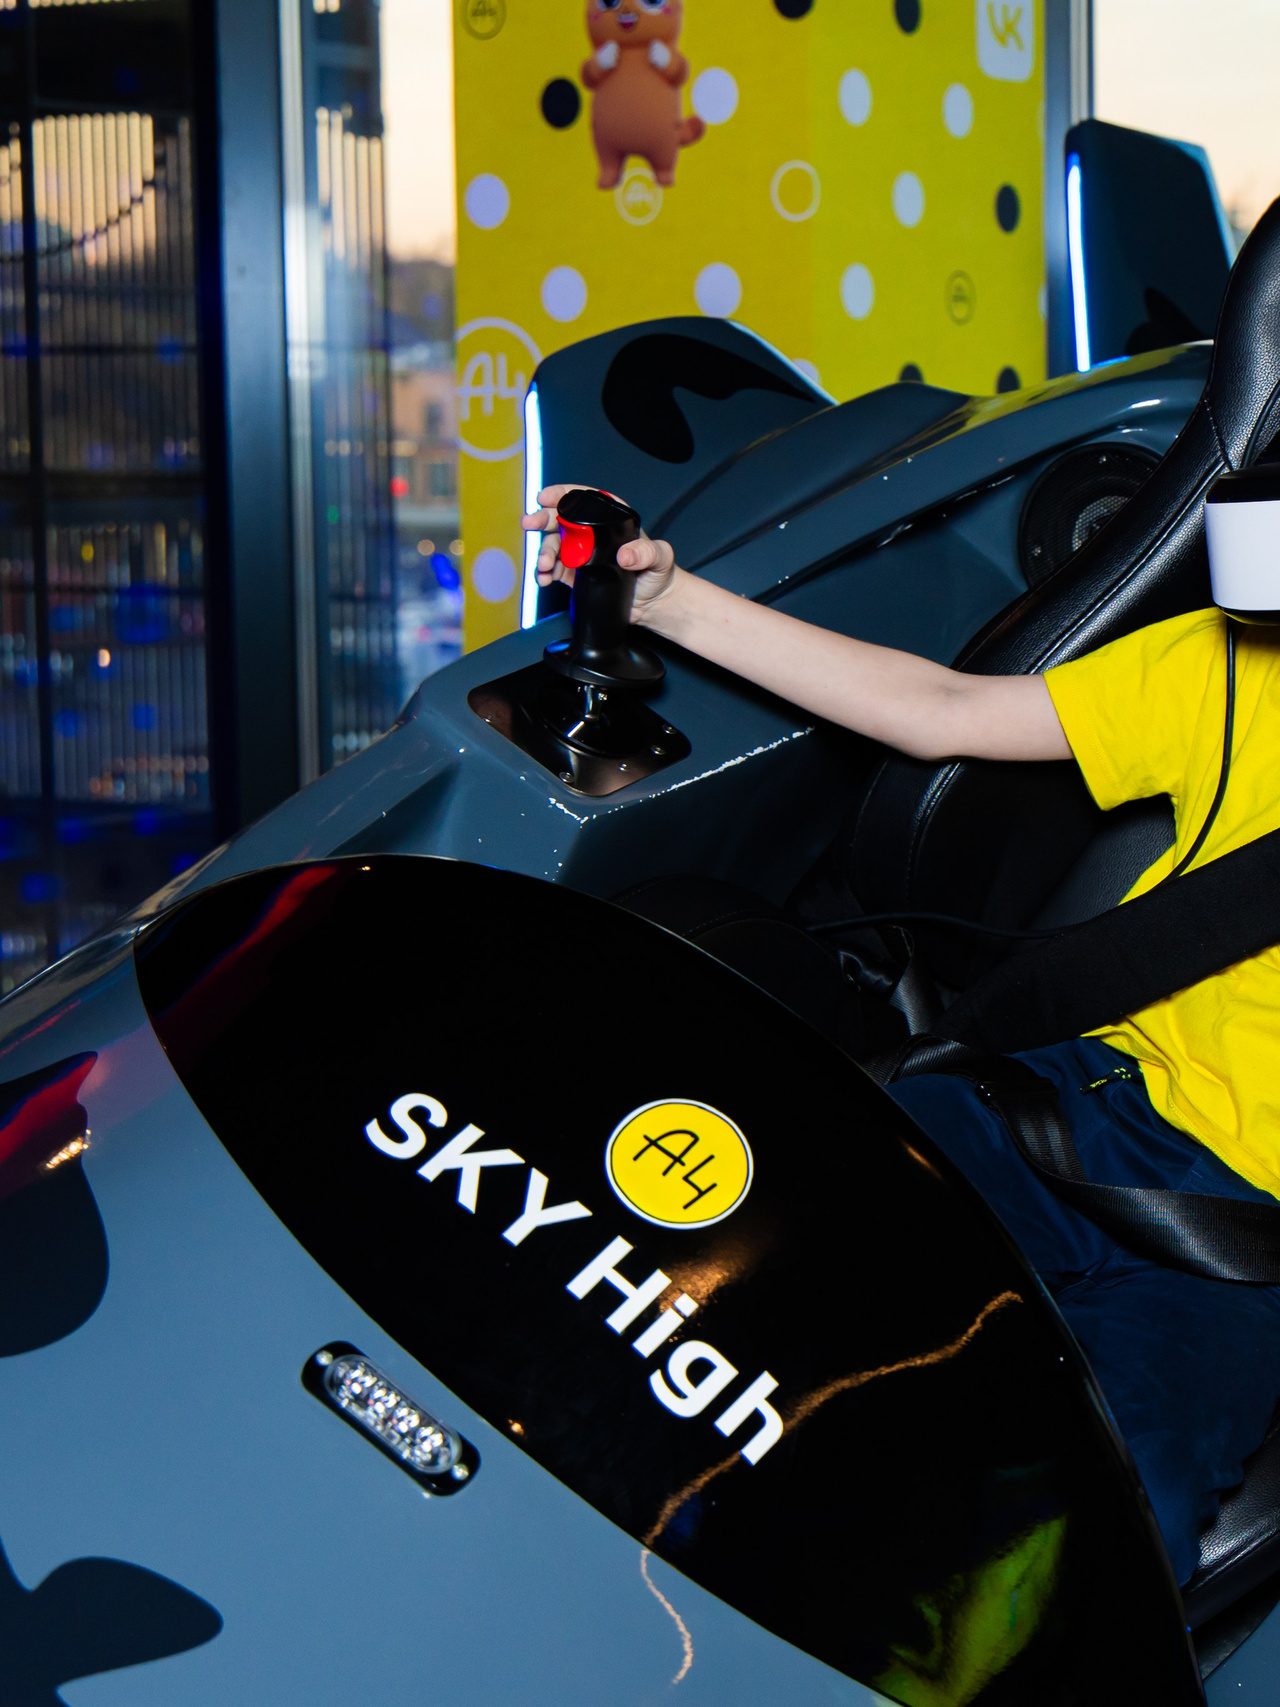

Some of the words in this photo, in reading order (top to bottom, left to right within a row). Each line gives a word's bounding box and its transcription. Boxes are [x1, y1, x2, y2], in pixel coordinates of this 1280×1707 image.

[457, 352, 525, 421] A4
[632, 1128, 718, 1211] A4
[364, 1092, 593, 1247] SKY
[565, 1234, 784, 1466] High
